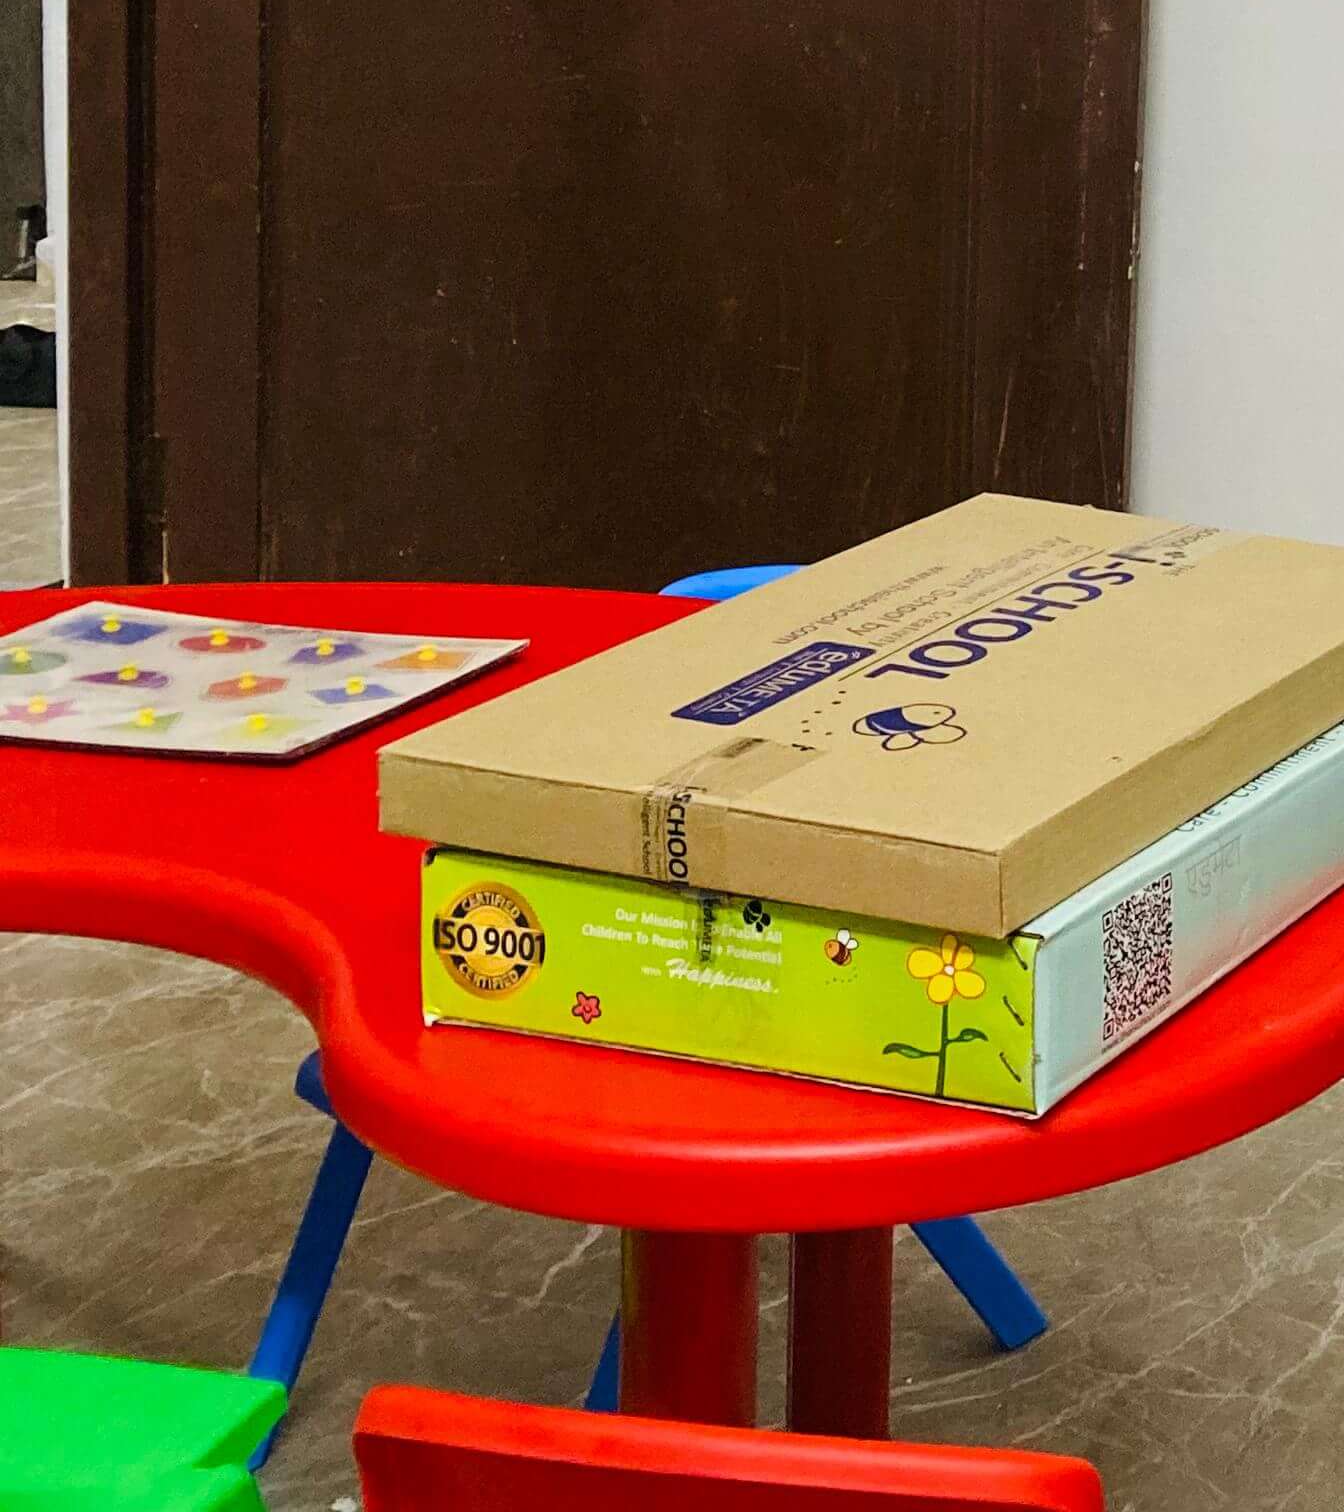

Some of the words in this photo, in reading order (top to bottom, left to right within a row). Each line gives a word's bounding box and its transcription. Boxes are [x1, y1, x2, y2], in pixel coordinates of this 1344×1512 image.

[864, 551, 1174, 680] i-SCHOOL
[878, 587, 958, 625] School
[846, 620, 890, 637] by
[710, 649, 850, 715] eduMETA
[460, 891, 521, 919] CERTIFIED
[615, 907, 638, 922] Our
[641, 911, 689, 930] Mission
[433, 917, 478, 953] ISO
[484, 926, 546, 965] 9001
[582, 923, 633, 943] Children
[636, 931, 649, 945] To
[651, 934, 689, 951] Reach
[458, 961, 521, 991] CERTIFIED
